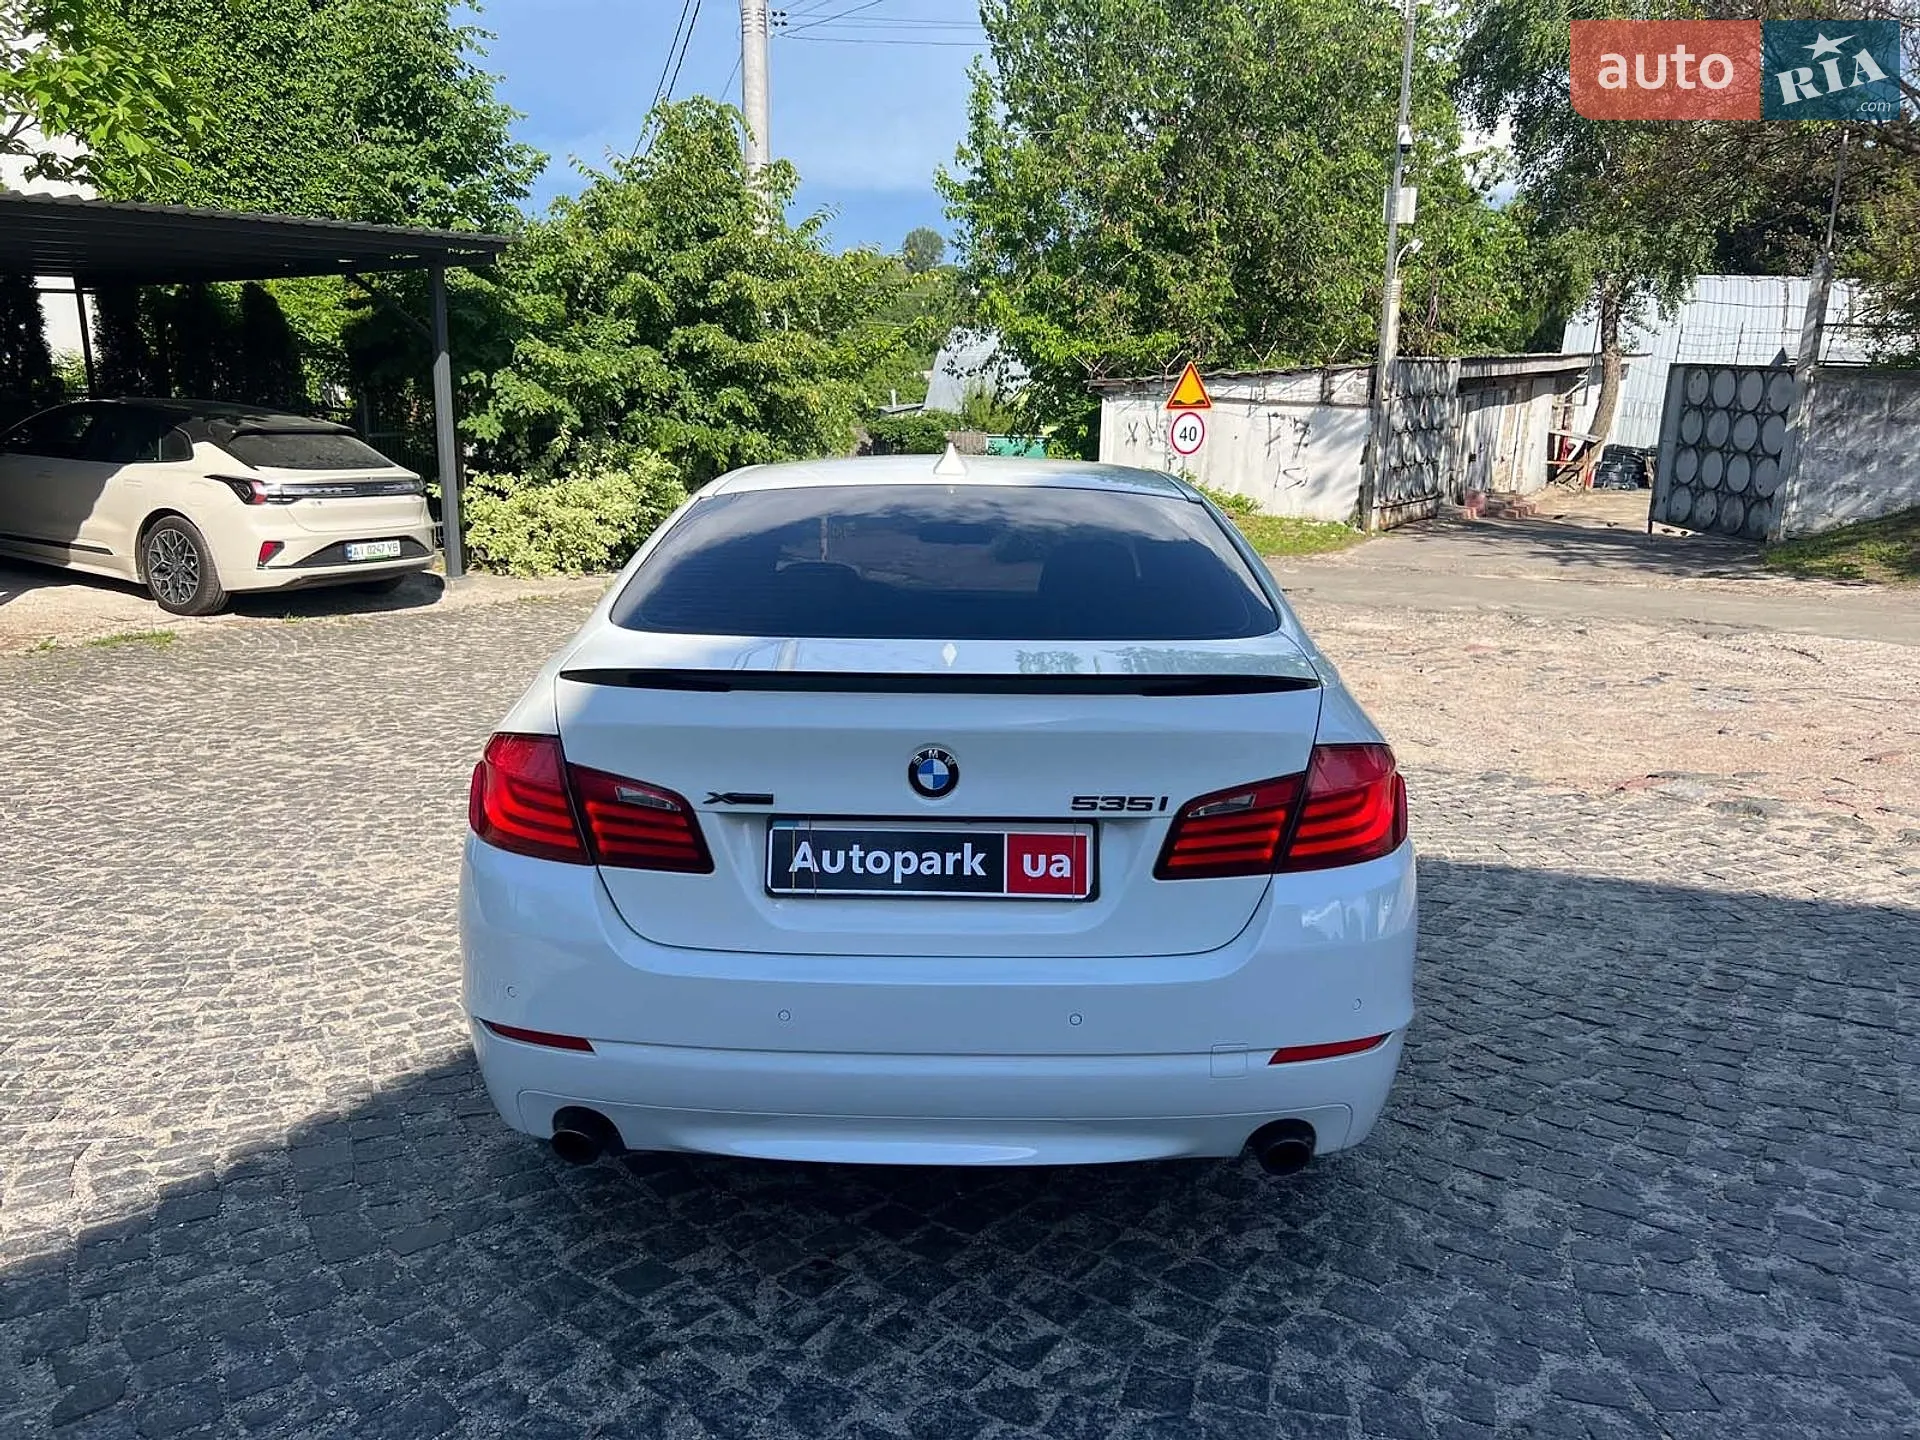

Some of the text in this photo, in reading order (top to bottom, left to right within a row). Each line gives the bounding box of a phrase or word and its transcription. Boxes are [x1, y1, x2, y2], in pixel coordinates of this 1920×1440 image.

[1179, 426, 1198, 442] 40
[913, 749, 957, 767] BMW
[788, 841, 1072, 884] Autopark ua
